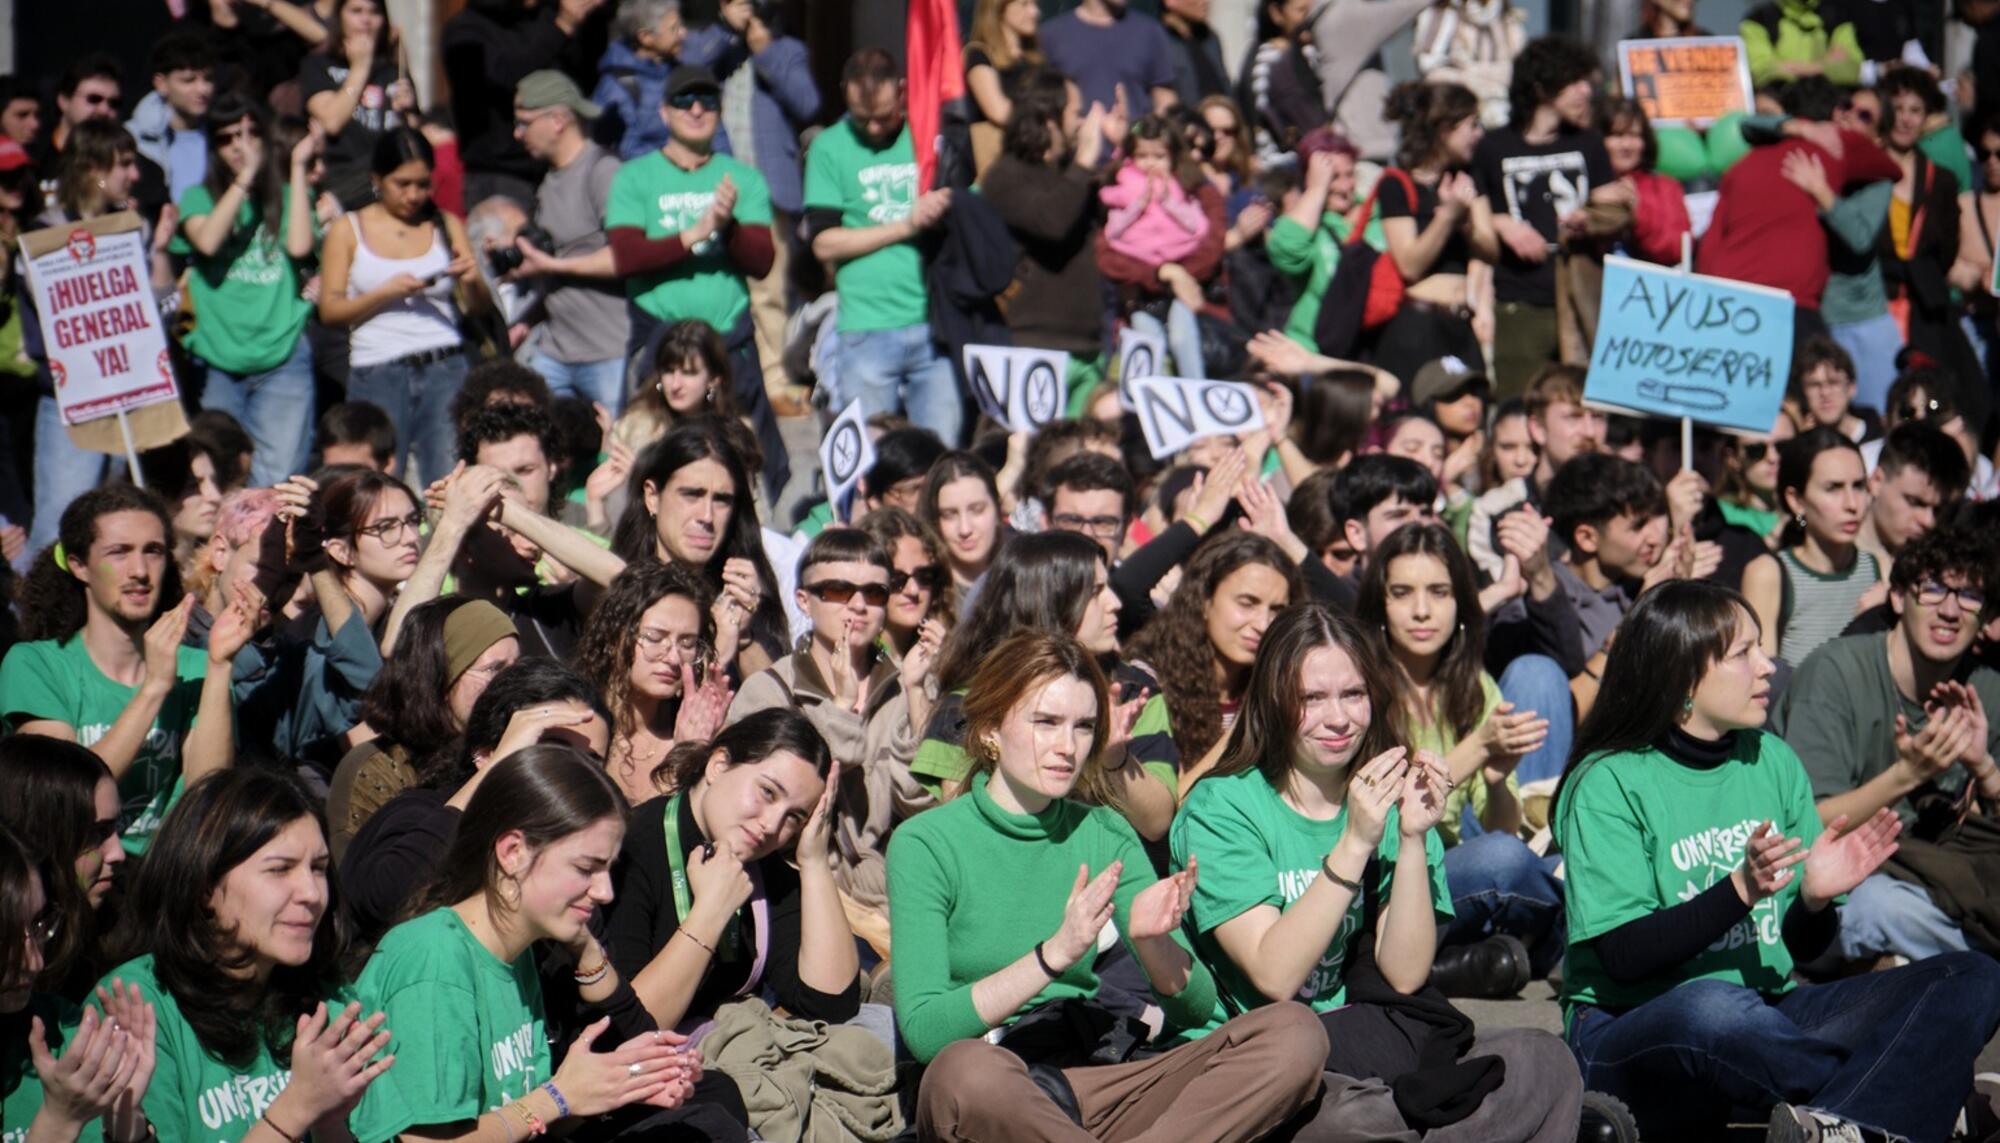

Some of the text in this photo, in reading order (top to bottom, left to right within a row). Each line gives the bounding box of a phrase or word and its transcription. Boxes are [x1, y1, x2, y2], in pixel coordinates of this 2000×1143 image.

[48, 264, 139, 315] ¡HUELGA
[1619, 275, 1761, 335] AYUSO
[54, 301, 150, 349] GENERAL
[93, 344, 130, 378] YA!
[1601, 336, 1773, 388] MOTOSIERRA
[971, 355, 1059, 427] NO
[1141, 383, 1252, 447] NO
